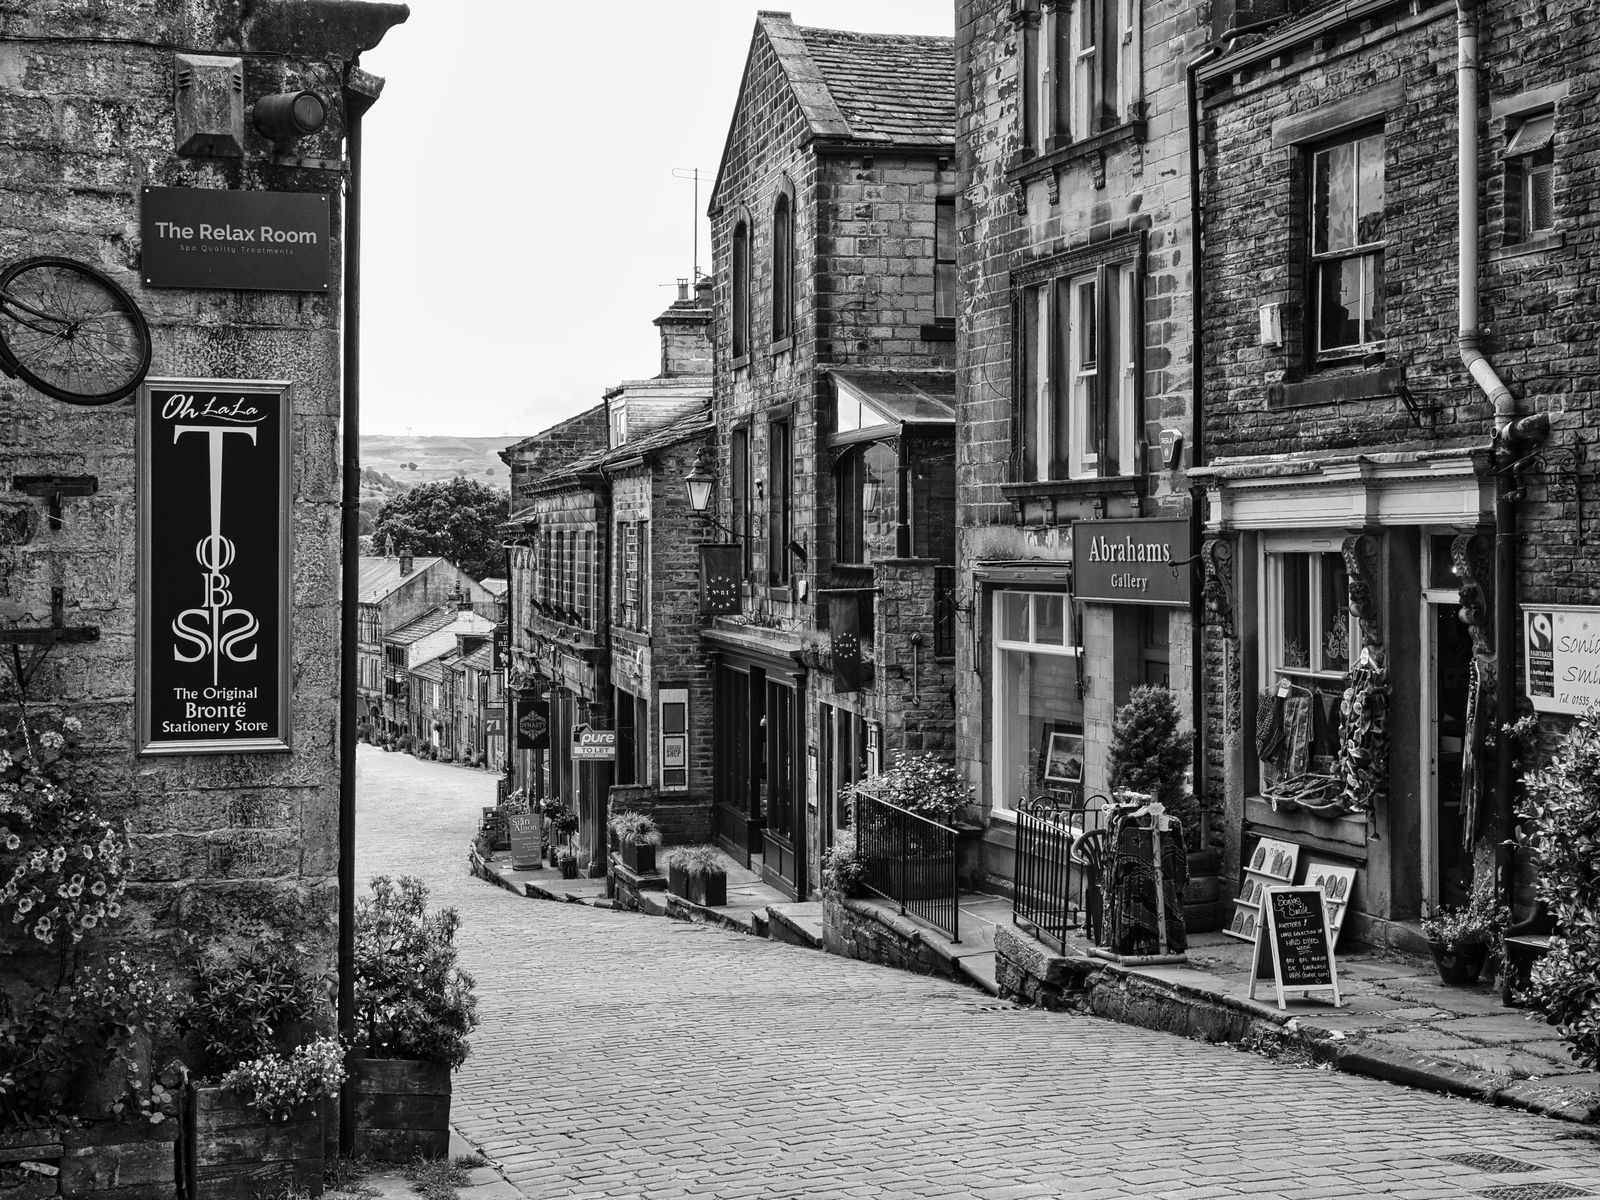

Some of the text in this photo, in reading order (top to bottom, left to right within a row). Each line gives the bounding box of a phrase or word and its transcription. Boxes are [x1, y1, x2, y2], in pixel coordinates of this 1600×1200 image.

[155, 222, 317, 244] The Relax Room
[179, 244, 294, 255] Spa Quality Treatments
[161, 393, 199, 420] Oh
[1089, 535, 1171, 563] Abrahams
[1111, 573, 1148, 592] Gallery
[1562, 664, 1600, 685] Smi
[174, 687, 258, 701] The Original
[1571, 695, 1590, 706] 01535
[185, 701, 246, 718] Brontë
[162, 719, 268, 733] Stationery Store
[486, 719, 501, 732] 71
[580, 733, 615, 746] pure
